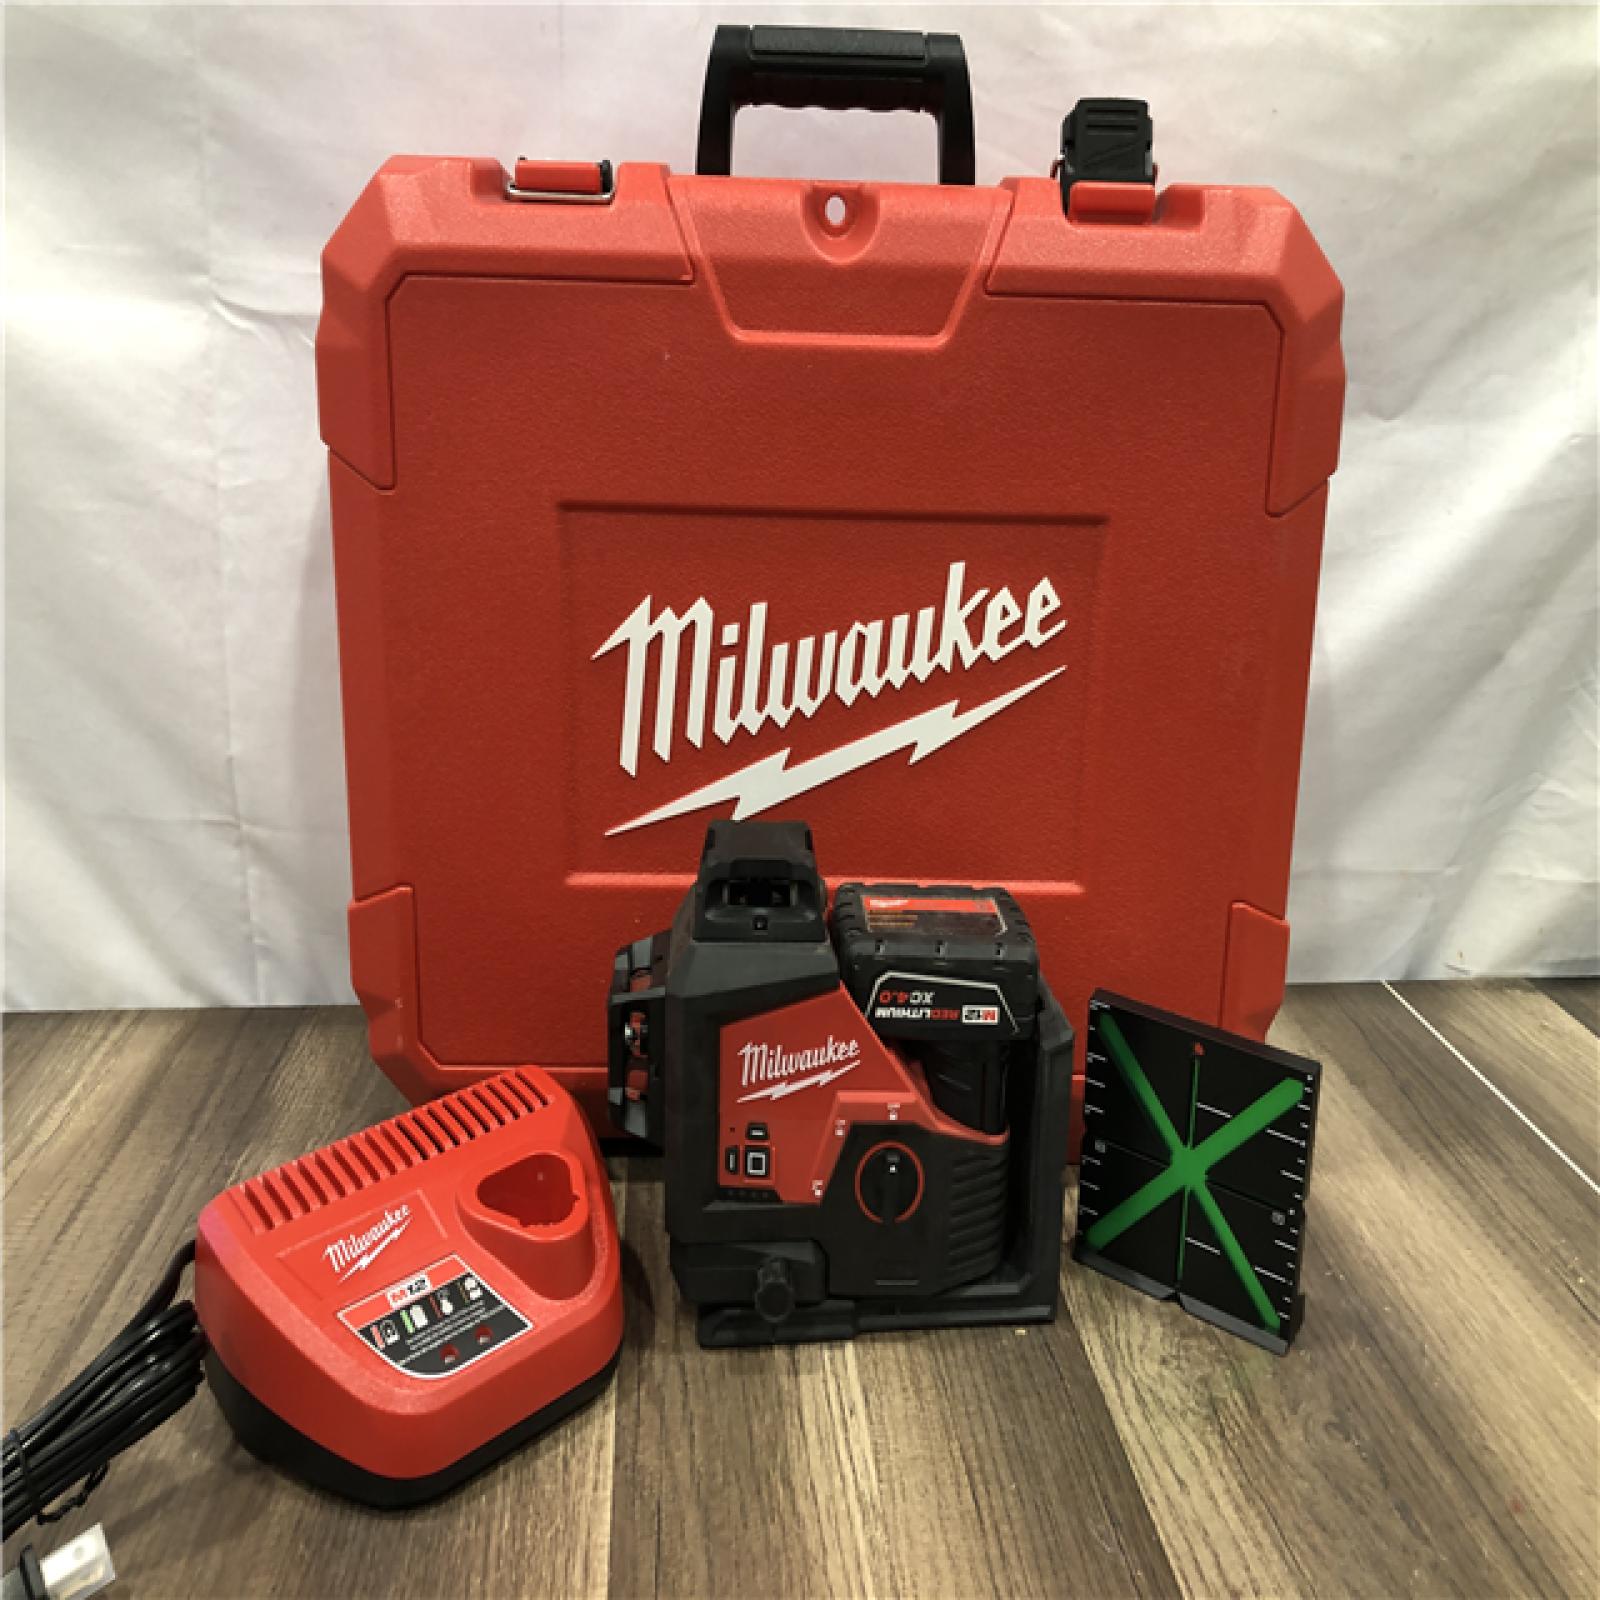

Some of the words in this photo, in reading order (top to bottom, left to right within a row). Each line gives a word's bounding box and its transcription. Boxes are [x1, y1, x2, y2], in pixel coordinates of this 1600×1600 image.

[592, 561, 1067, 777] Milwaukee
[737, 1035, 860, 1086] Milwaukee
[322, 1205, 410, 1272] Milwaukee
